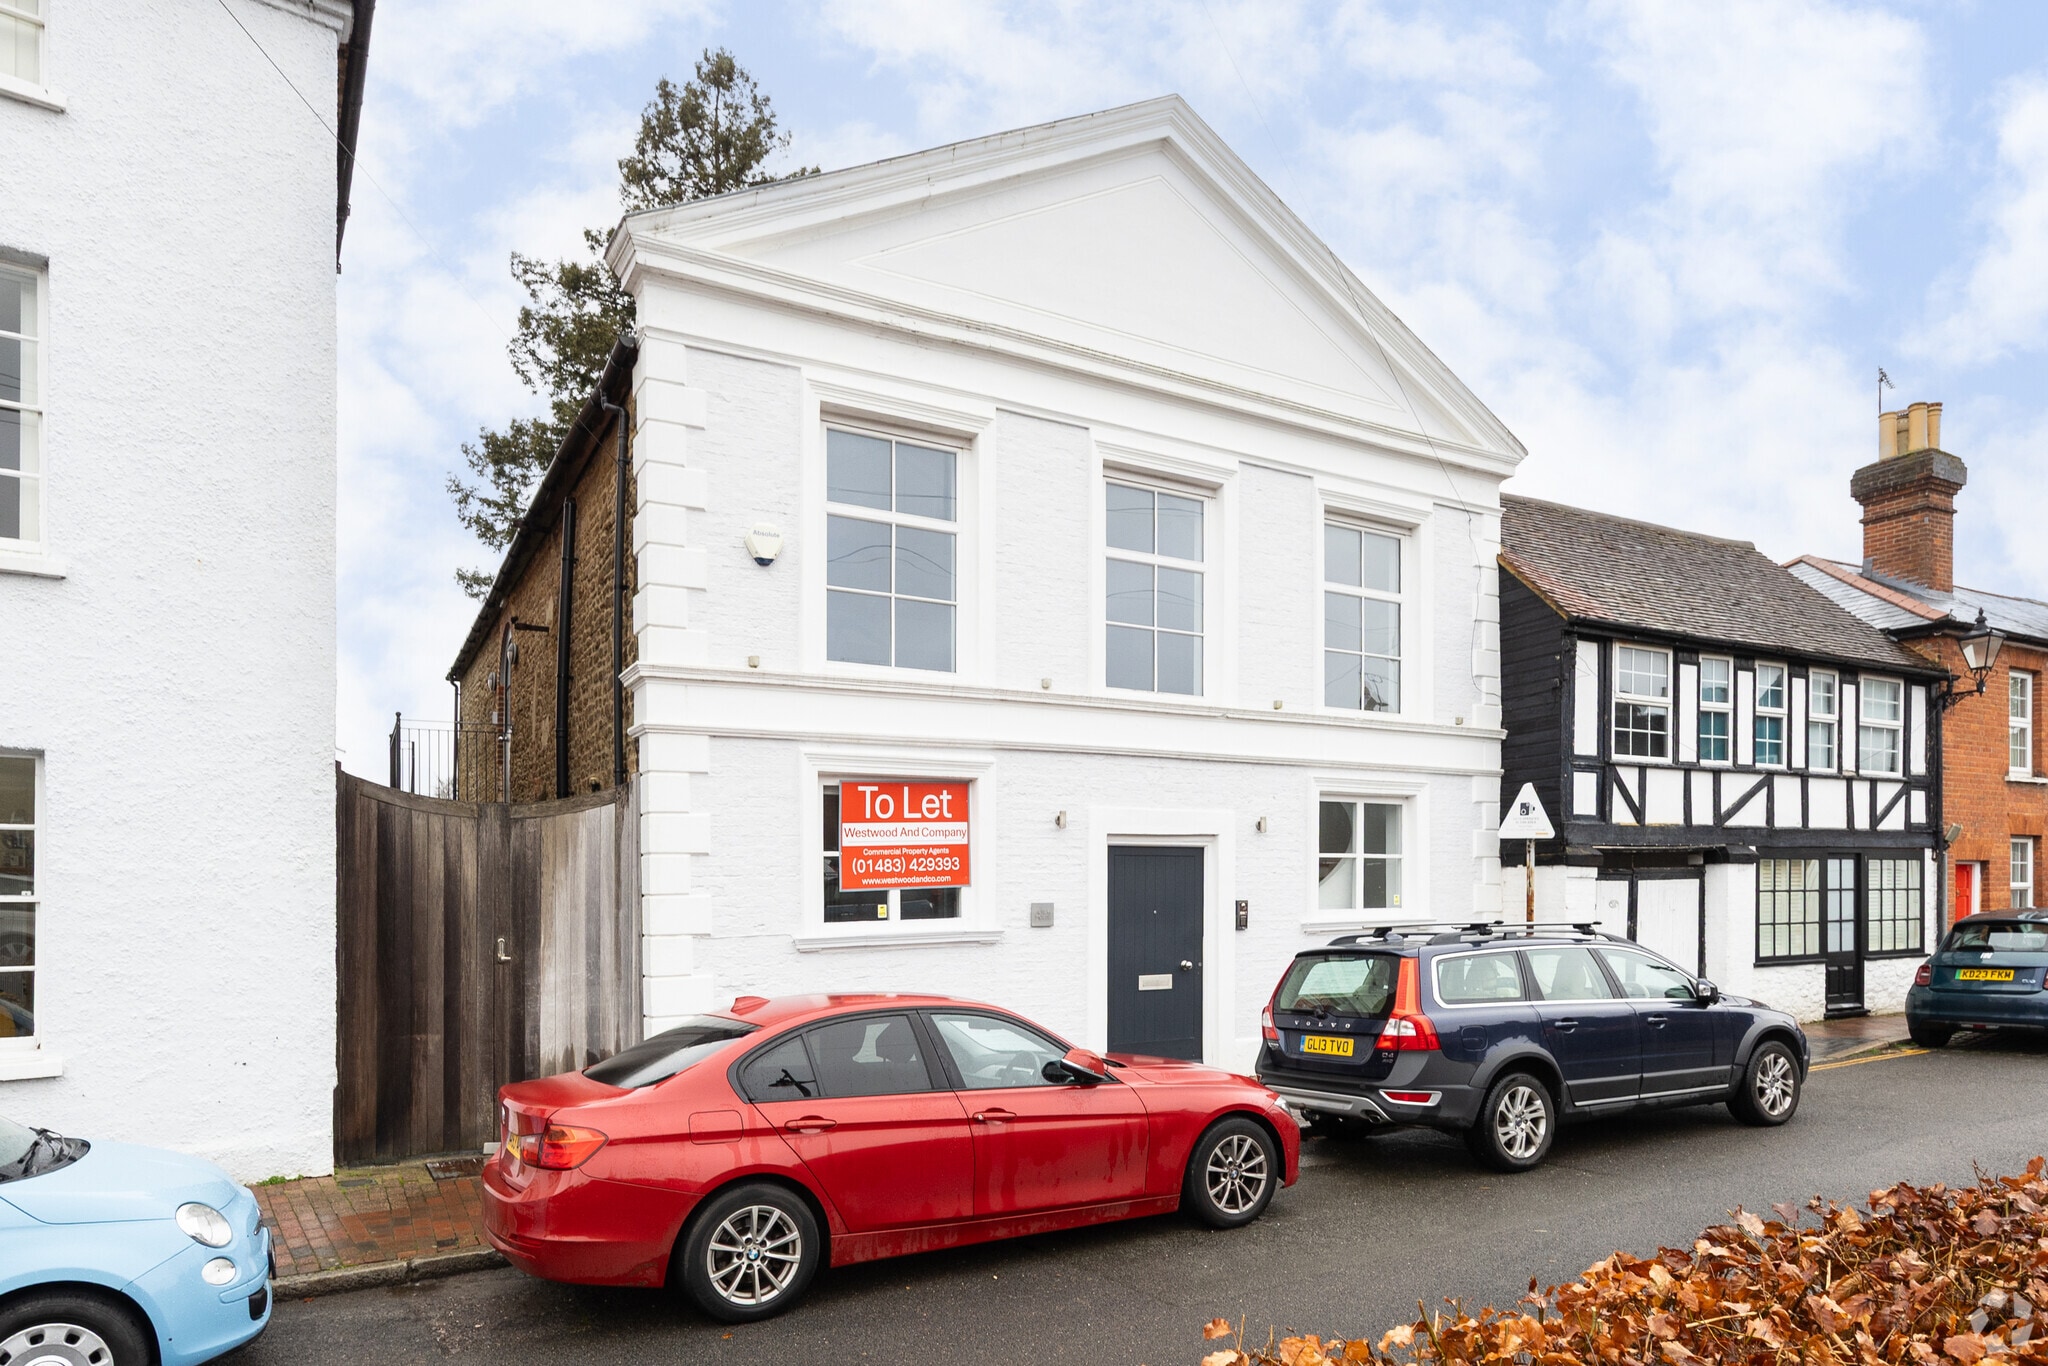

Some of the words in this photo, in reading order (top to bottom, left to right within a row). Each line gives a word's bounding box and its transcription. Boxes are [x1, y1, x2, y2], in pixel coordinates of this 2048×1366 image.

[857, 785, 895, 819] To
[903, 786, 953, 819] Let
[844, 827, 898, 838] Westwood
[900, 827, 920, 837] And
[921, 827, 967, 839] Company
[863, 848, 902, 856] Commercial
[902, 847, 928, 857] Property
[928, 847, 950, 856] Agents
[852, 857, 906, 875] (01483)
[909, 857, 960, 872] 429393
[861, 875, 952, 885] www.westwoodandco.com
[1962, 970, 1988, 978] KD23
[1294, 1019, 1351, 1029] VOLVO
[1307, 1037, 1327, 1051] GL13
[1329, 1039, 1349, 1053] TVO
